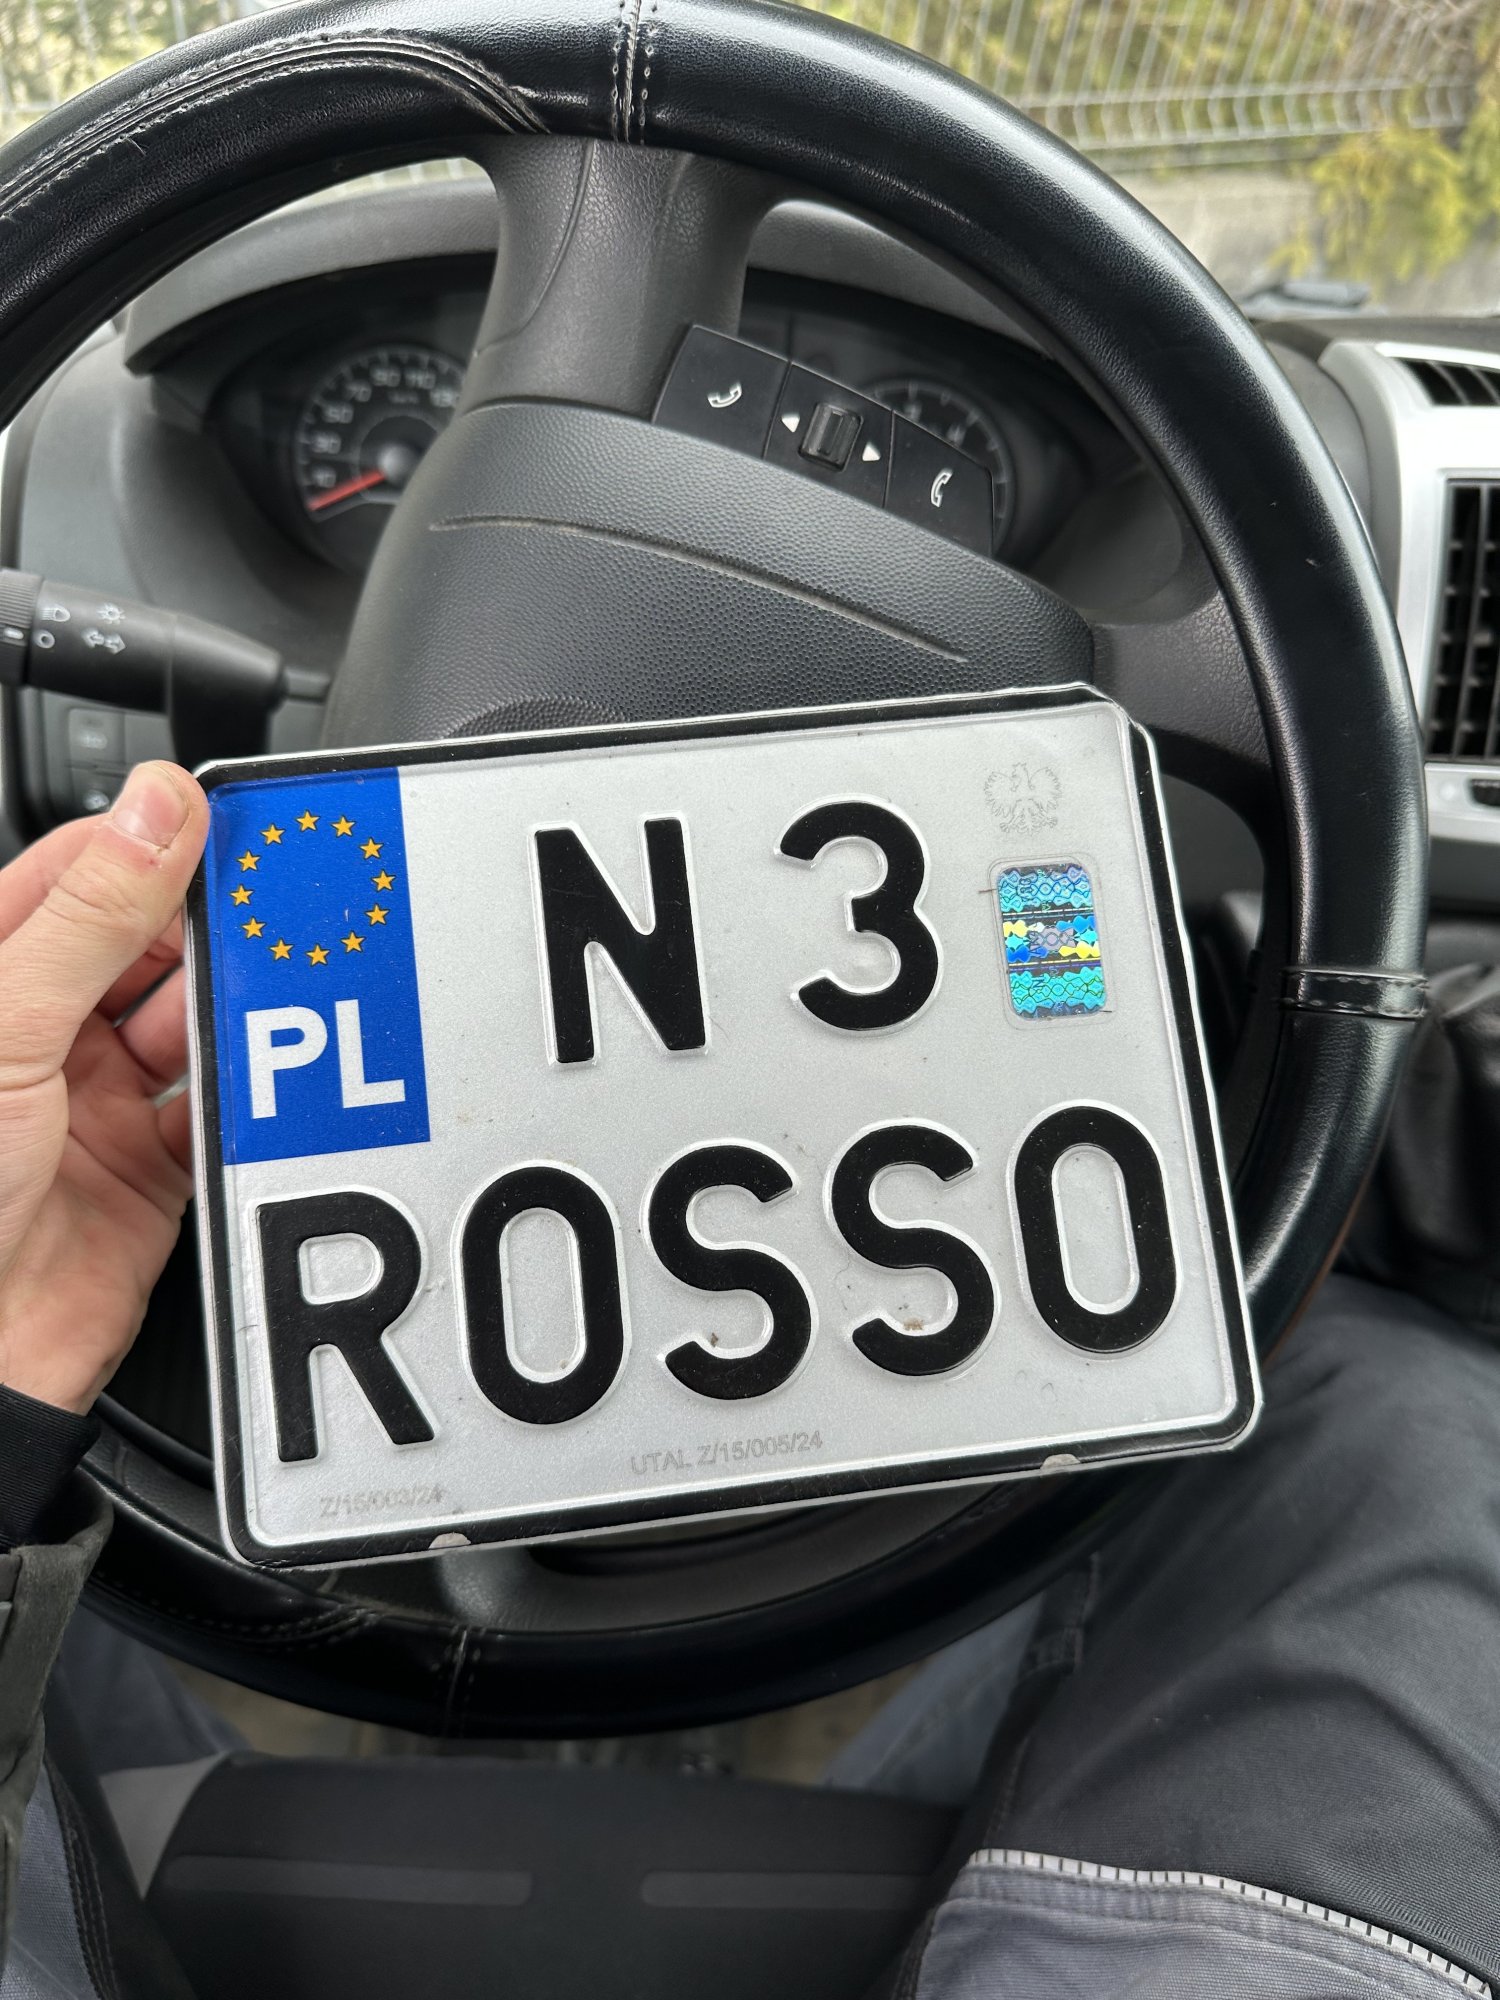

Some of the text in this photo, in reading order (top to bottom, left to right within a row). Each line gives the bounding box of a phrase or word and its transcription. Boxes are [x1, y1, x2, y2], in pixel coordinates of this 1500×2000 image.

[534, 816, 706, 1064] N
[780, 800, 939, 1032] 3
[245, 999, 406, 1120] PL
[256, 1105, 1177, 1462] ROSSO
[630, 1429, 824, 1475] UTAL Z/15/005/24
